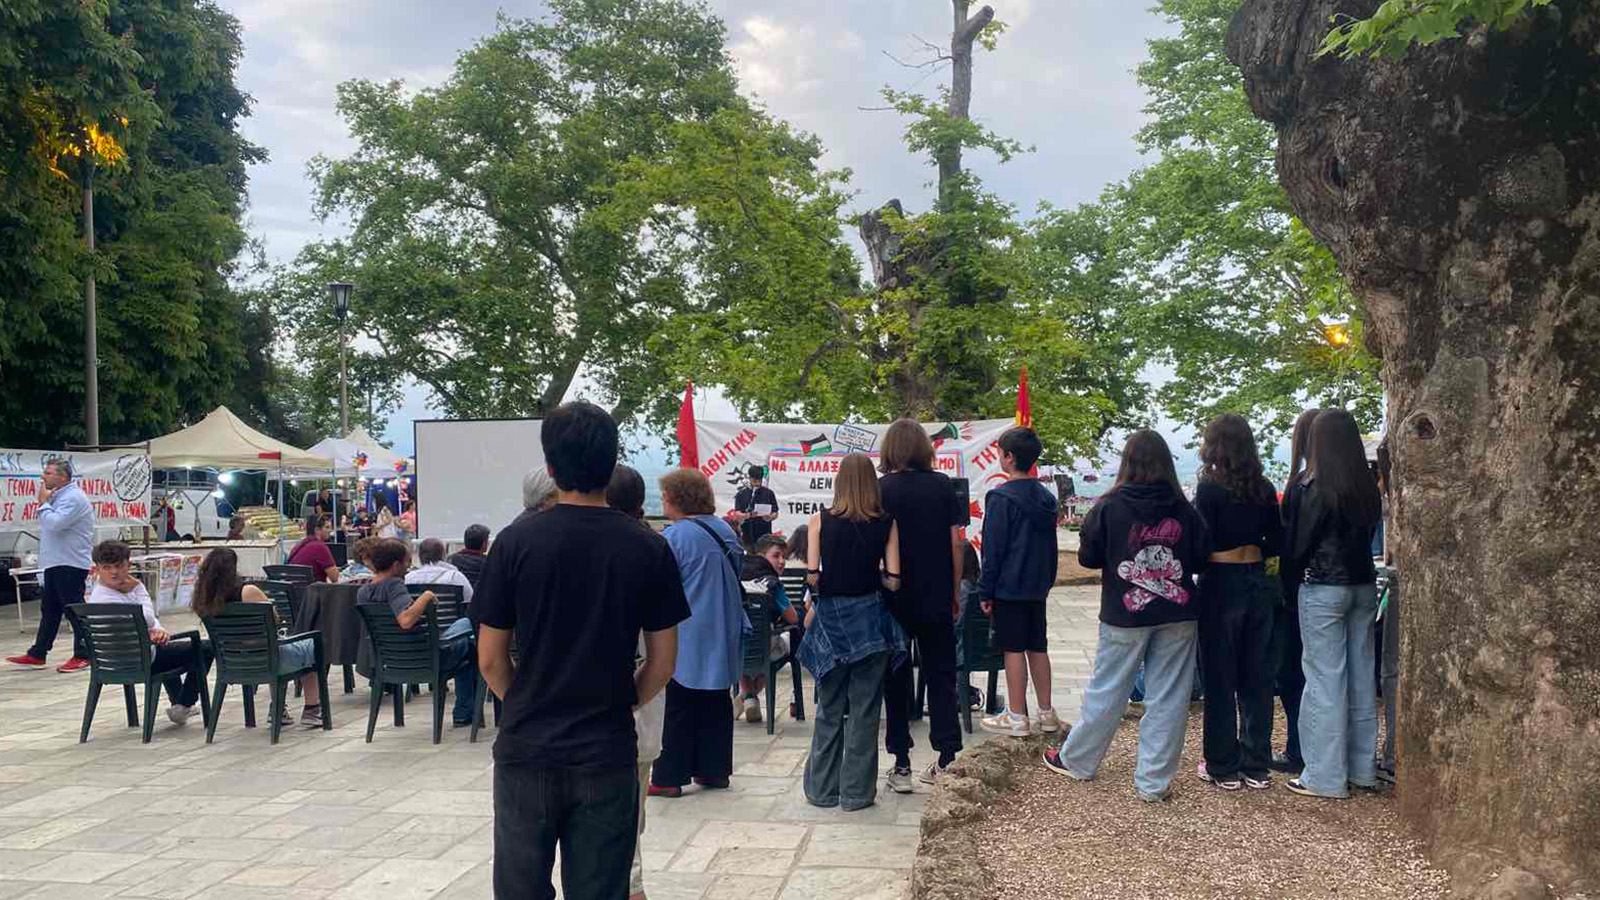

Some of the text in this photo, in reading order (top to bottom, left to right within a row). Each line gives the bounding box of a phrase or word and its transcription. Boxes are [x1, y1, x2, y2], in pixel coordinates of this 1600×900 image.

[701, 428, 758, 478] ΑΘΗΤΙΚΑ
[771, 460, 787, 472] ΝΑ
[799, 460, 839, 473] ΑΛΛΑΞ
[810, 477, 833, 490] ΔΕΝ
